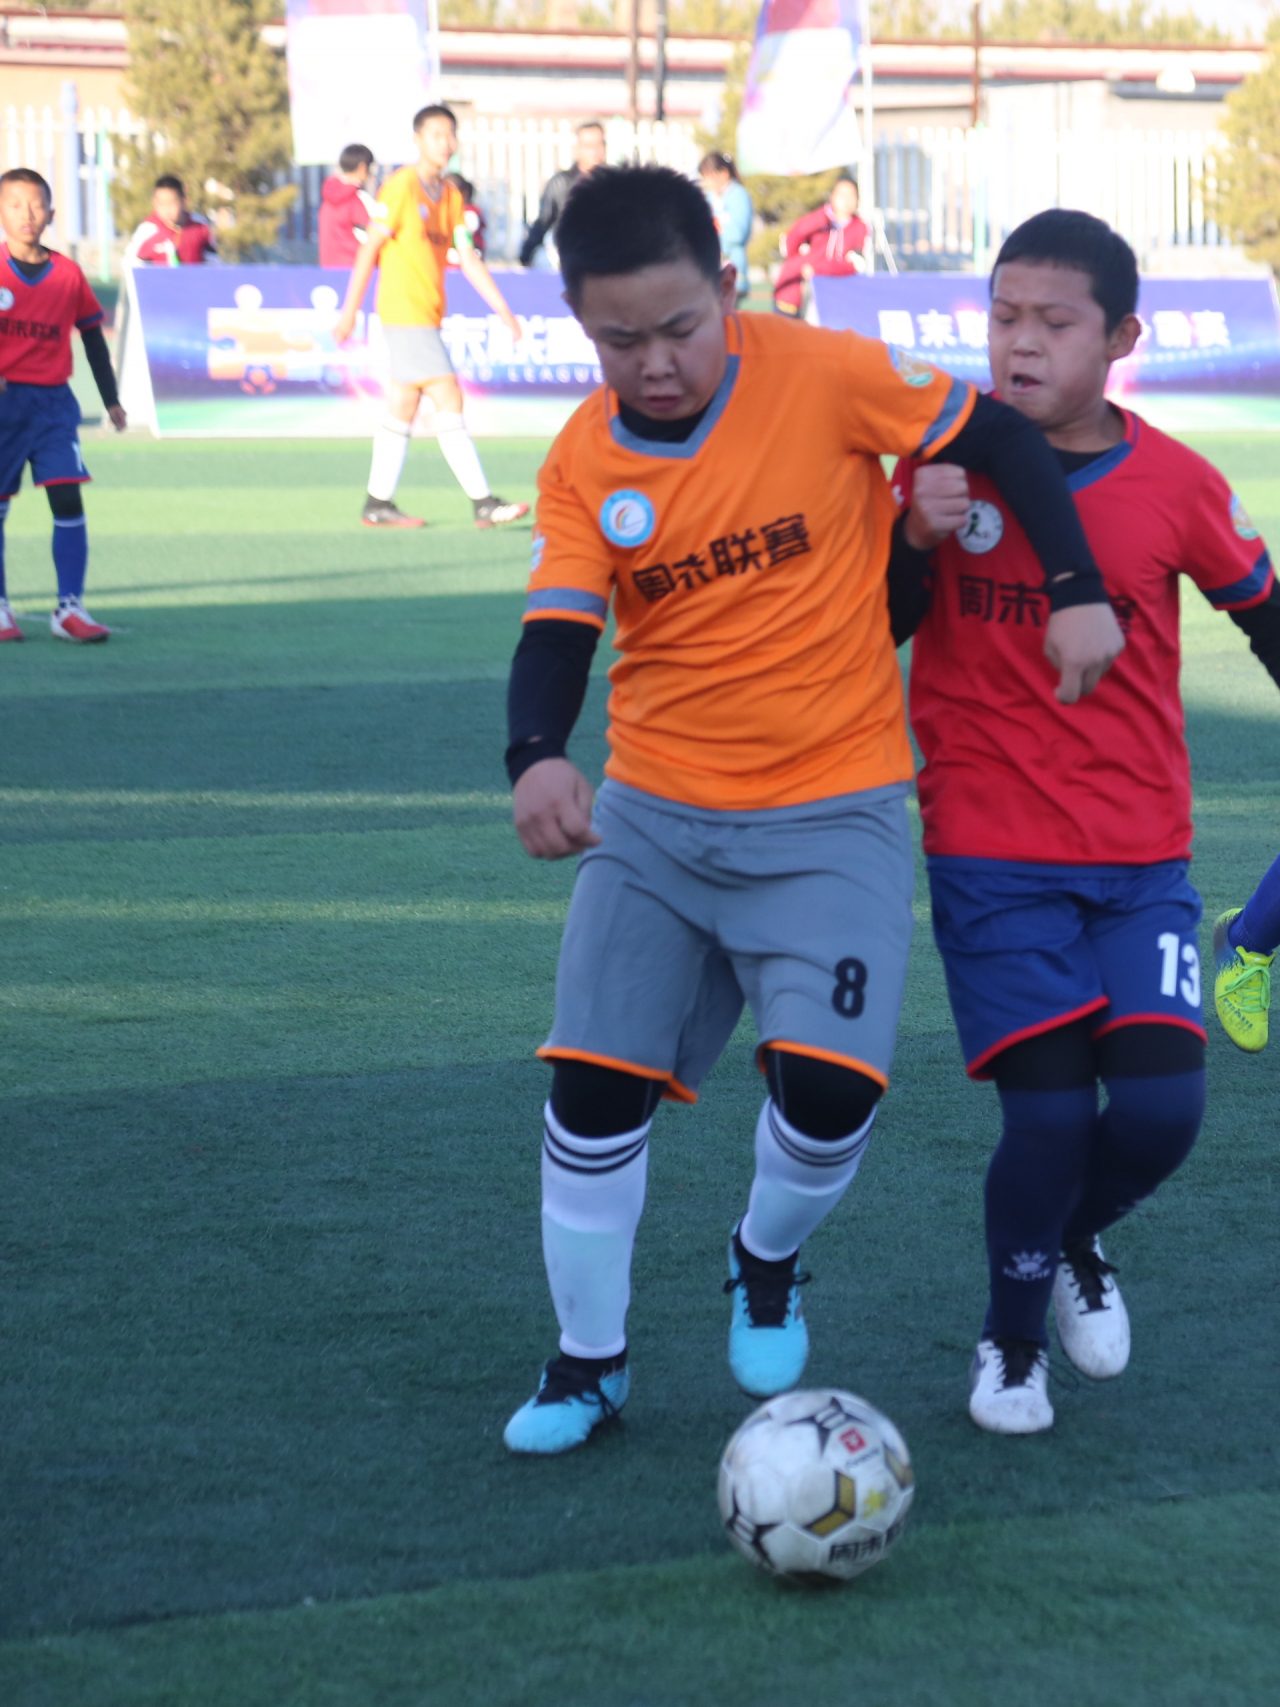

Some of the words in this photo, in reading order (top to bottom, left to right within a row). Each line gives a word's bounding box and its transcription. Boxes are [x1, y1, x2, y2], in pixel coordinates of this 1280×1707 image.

[632, 513, 812, 603] 周末联赛
[832, 957, 867, 1020] 8
[1158, 932, 1200, 1008] 13
